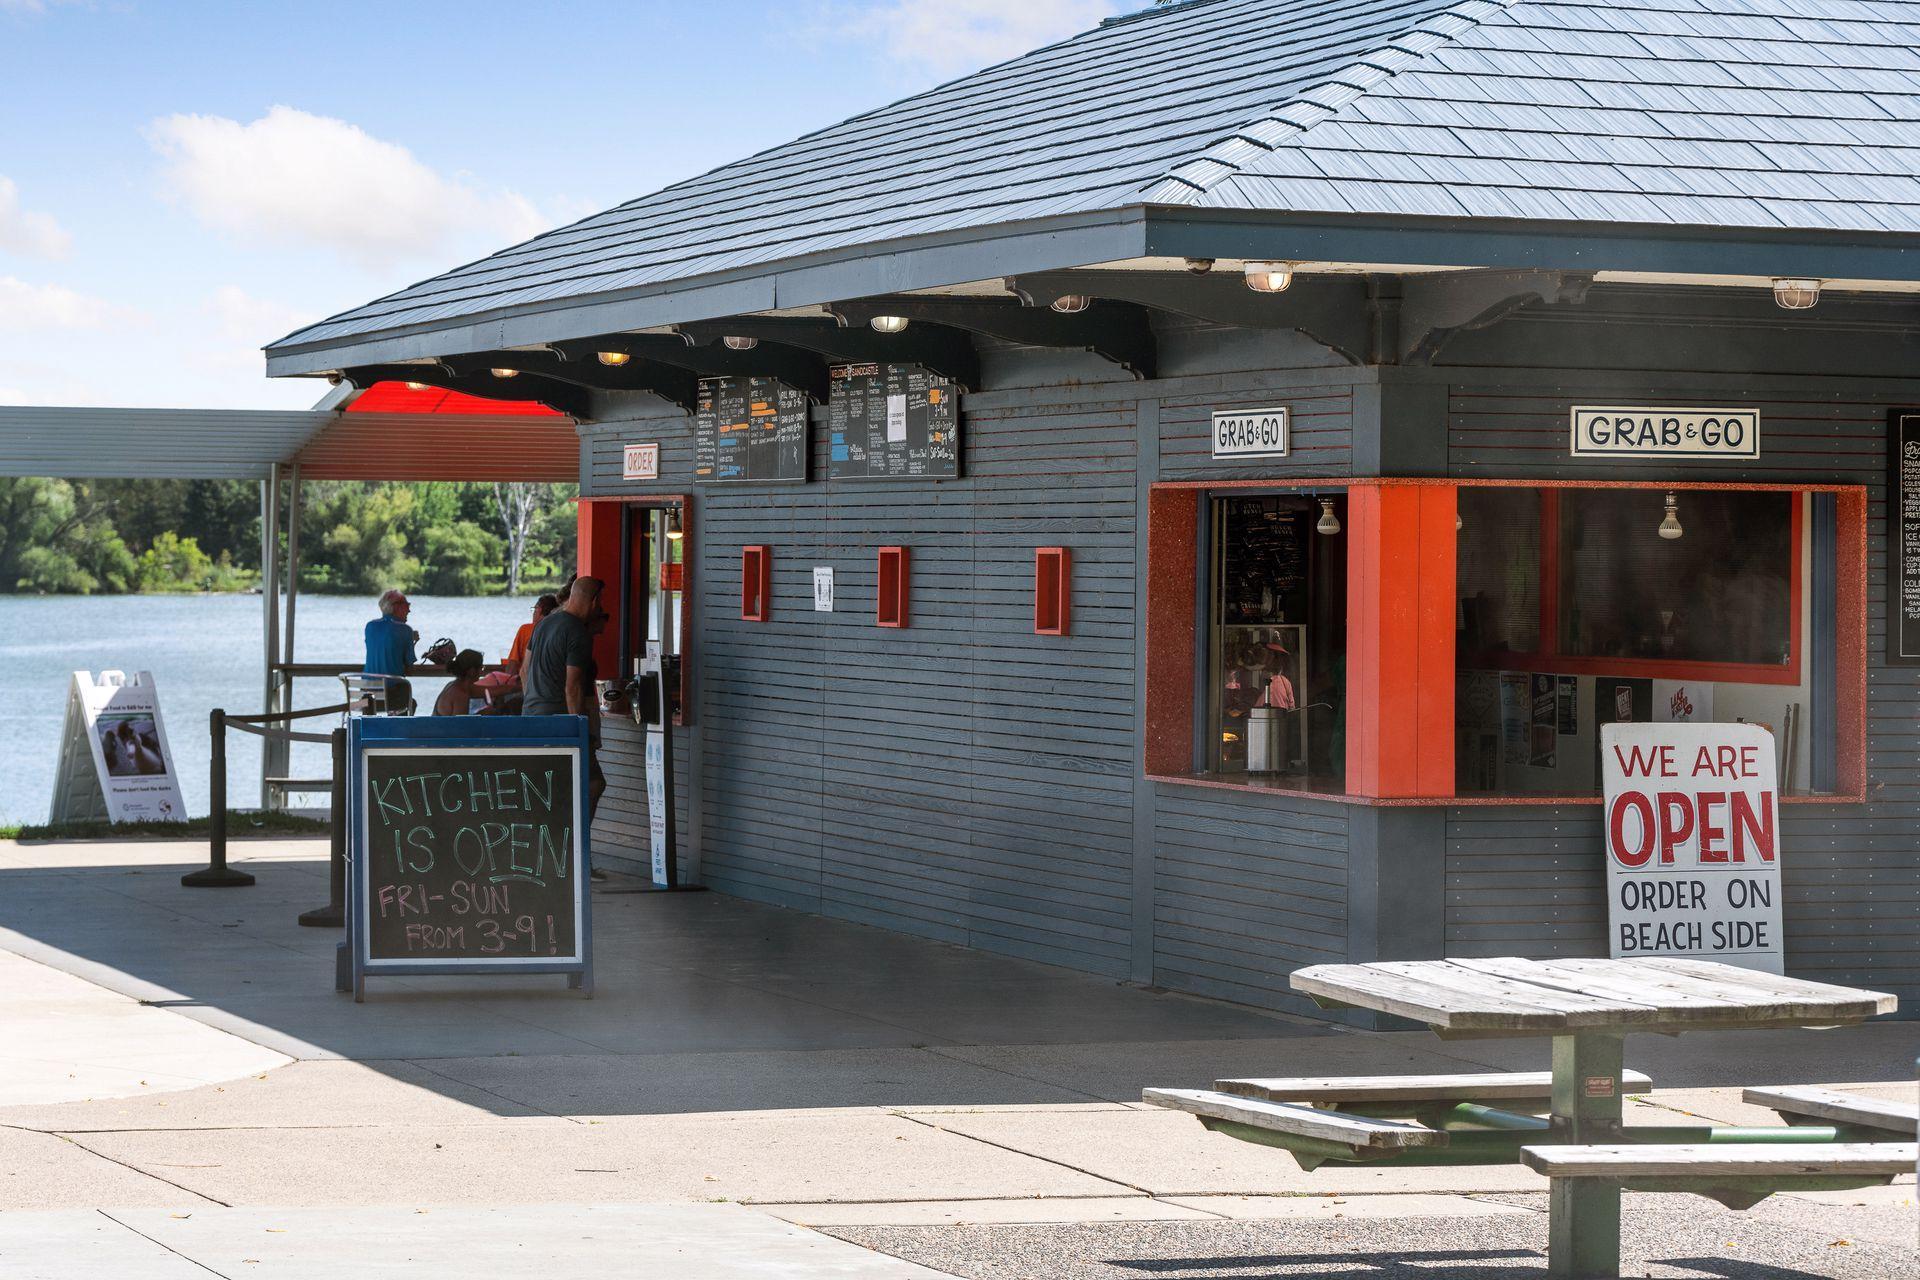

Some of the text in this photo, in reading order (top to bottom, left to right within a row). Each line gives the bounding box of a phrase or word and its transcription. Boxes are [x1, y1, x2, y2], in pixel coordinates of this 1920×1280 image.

[628, 452, 653, 471] ORDER
[1904, 460, 1920, 468] SNA
[1613, 744, 1759, 780] WE ARE
[372, 769, 553, 825] KITCHEN
[1608, 791, 1775, 867] OPEN
[394, 823, 570, 877] IS OPEN
[1620, 878, 1771, 912] ORDER ON
[405, 923, 466, 951] FROM
[1620, 921, 1769, 950] BEACH SIDE
